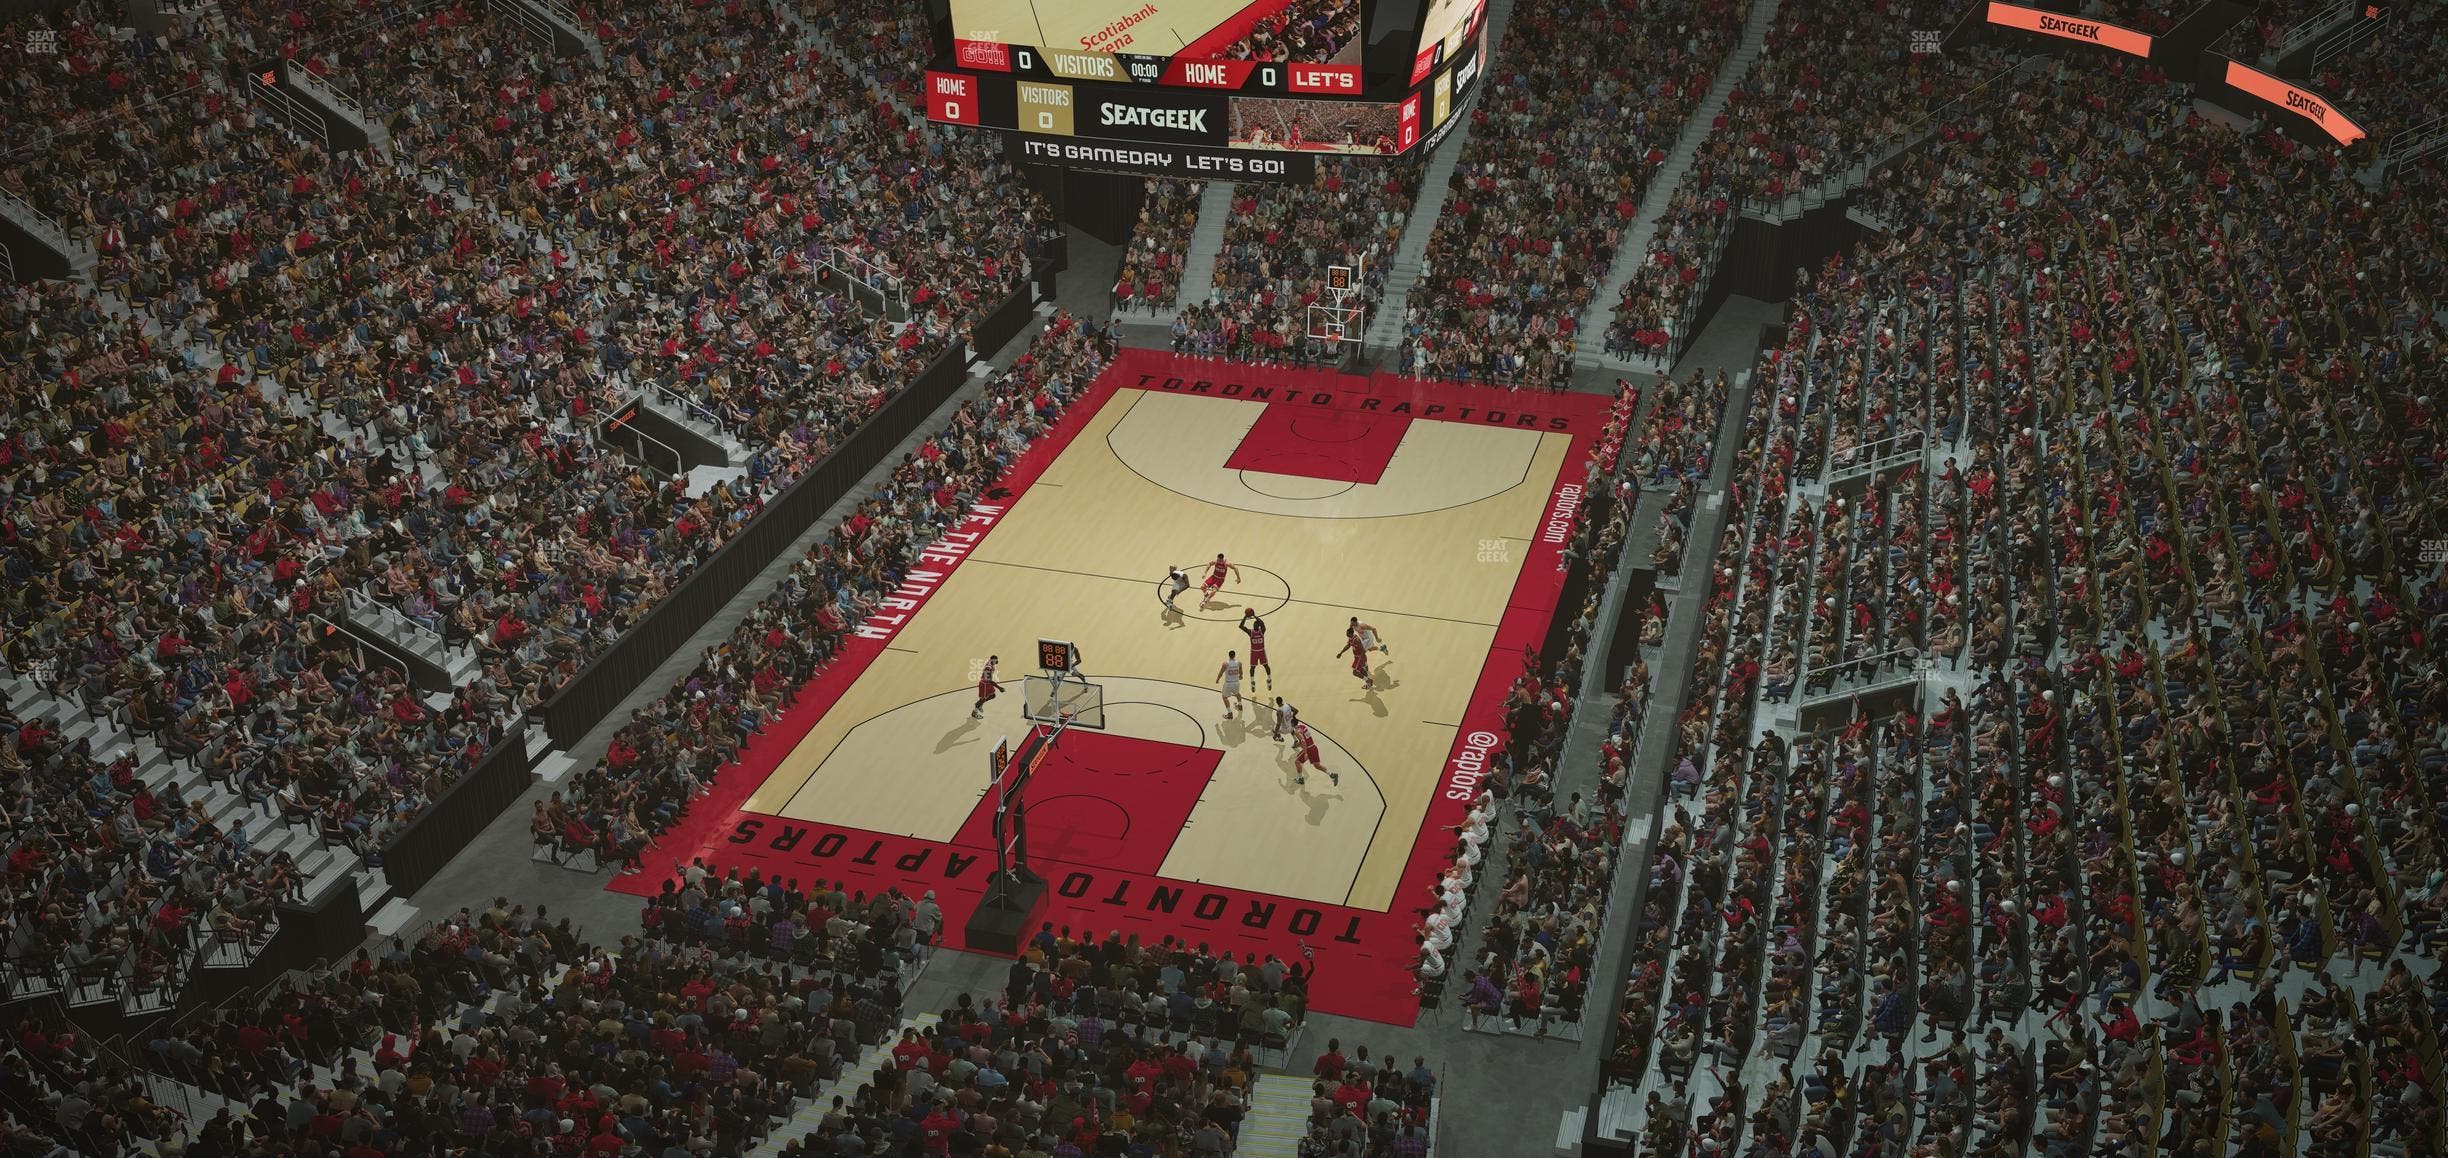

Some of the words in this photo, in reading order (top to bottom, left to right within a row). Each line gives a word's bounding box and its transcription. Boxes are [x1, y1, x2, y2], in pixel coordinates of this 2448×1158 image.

[1080, 3, 1158, 51] Scotiabank
[2039, 15, 2100, 41] SEATGEEK
[1019, 51, 1032, 70] 0
[1054, 54, 1114, 77] VISITORS
[1131, 63, 1158, 77] 00:00
[1185, 63, 1227, 85] HOME
[1262, 67, 1276, 86] 0
[1296, 71, 1354, 88] LET'S
[936, 77, 966, 97] HOME
[1021, 85, 1070, 106] VISITORS
[945, 101, 960, 119] 0
[1100, 102, 1208, 133] SEATGEEK
[2285, 90, 2328, 124] SEATGEEK
[1038, 111, 1053, 129] 0
[1405, 125, 1412, 145] 0
[1024, 141, 1060, 157] IT'S
[1065, 145, 1173, 167] GAMEDAY
[1186, 154, 1244, 171] LET'S
[1250, 158, 1285, 174] GO!
[1137, 374, 1333, 406] TORONTO
[1360, 397, 1571, 431] RAPTORS
[970, 504, 1004, 526] WE
[1543, 483, 1583, 543] raptors.com
[919, 532, 980, 566] THE
[855, 569, 943, 640] NORTH
[1045, 653, 1064, 668] 88
[1446, 731, 1499, 801] @raptors
[728, 820, 978, 879] APTORS
[1058, 872, 1361, 944] TORONTO
